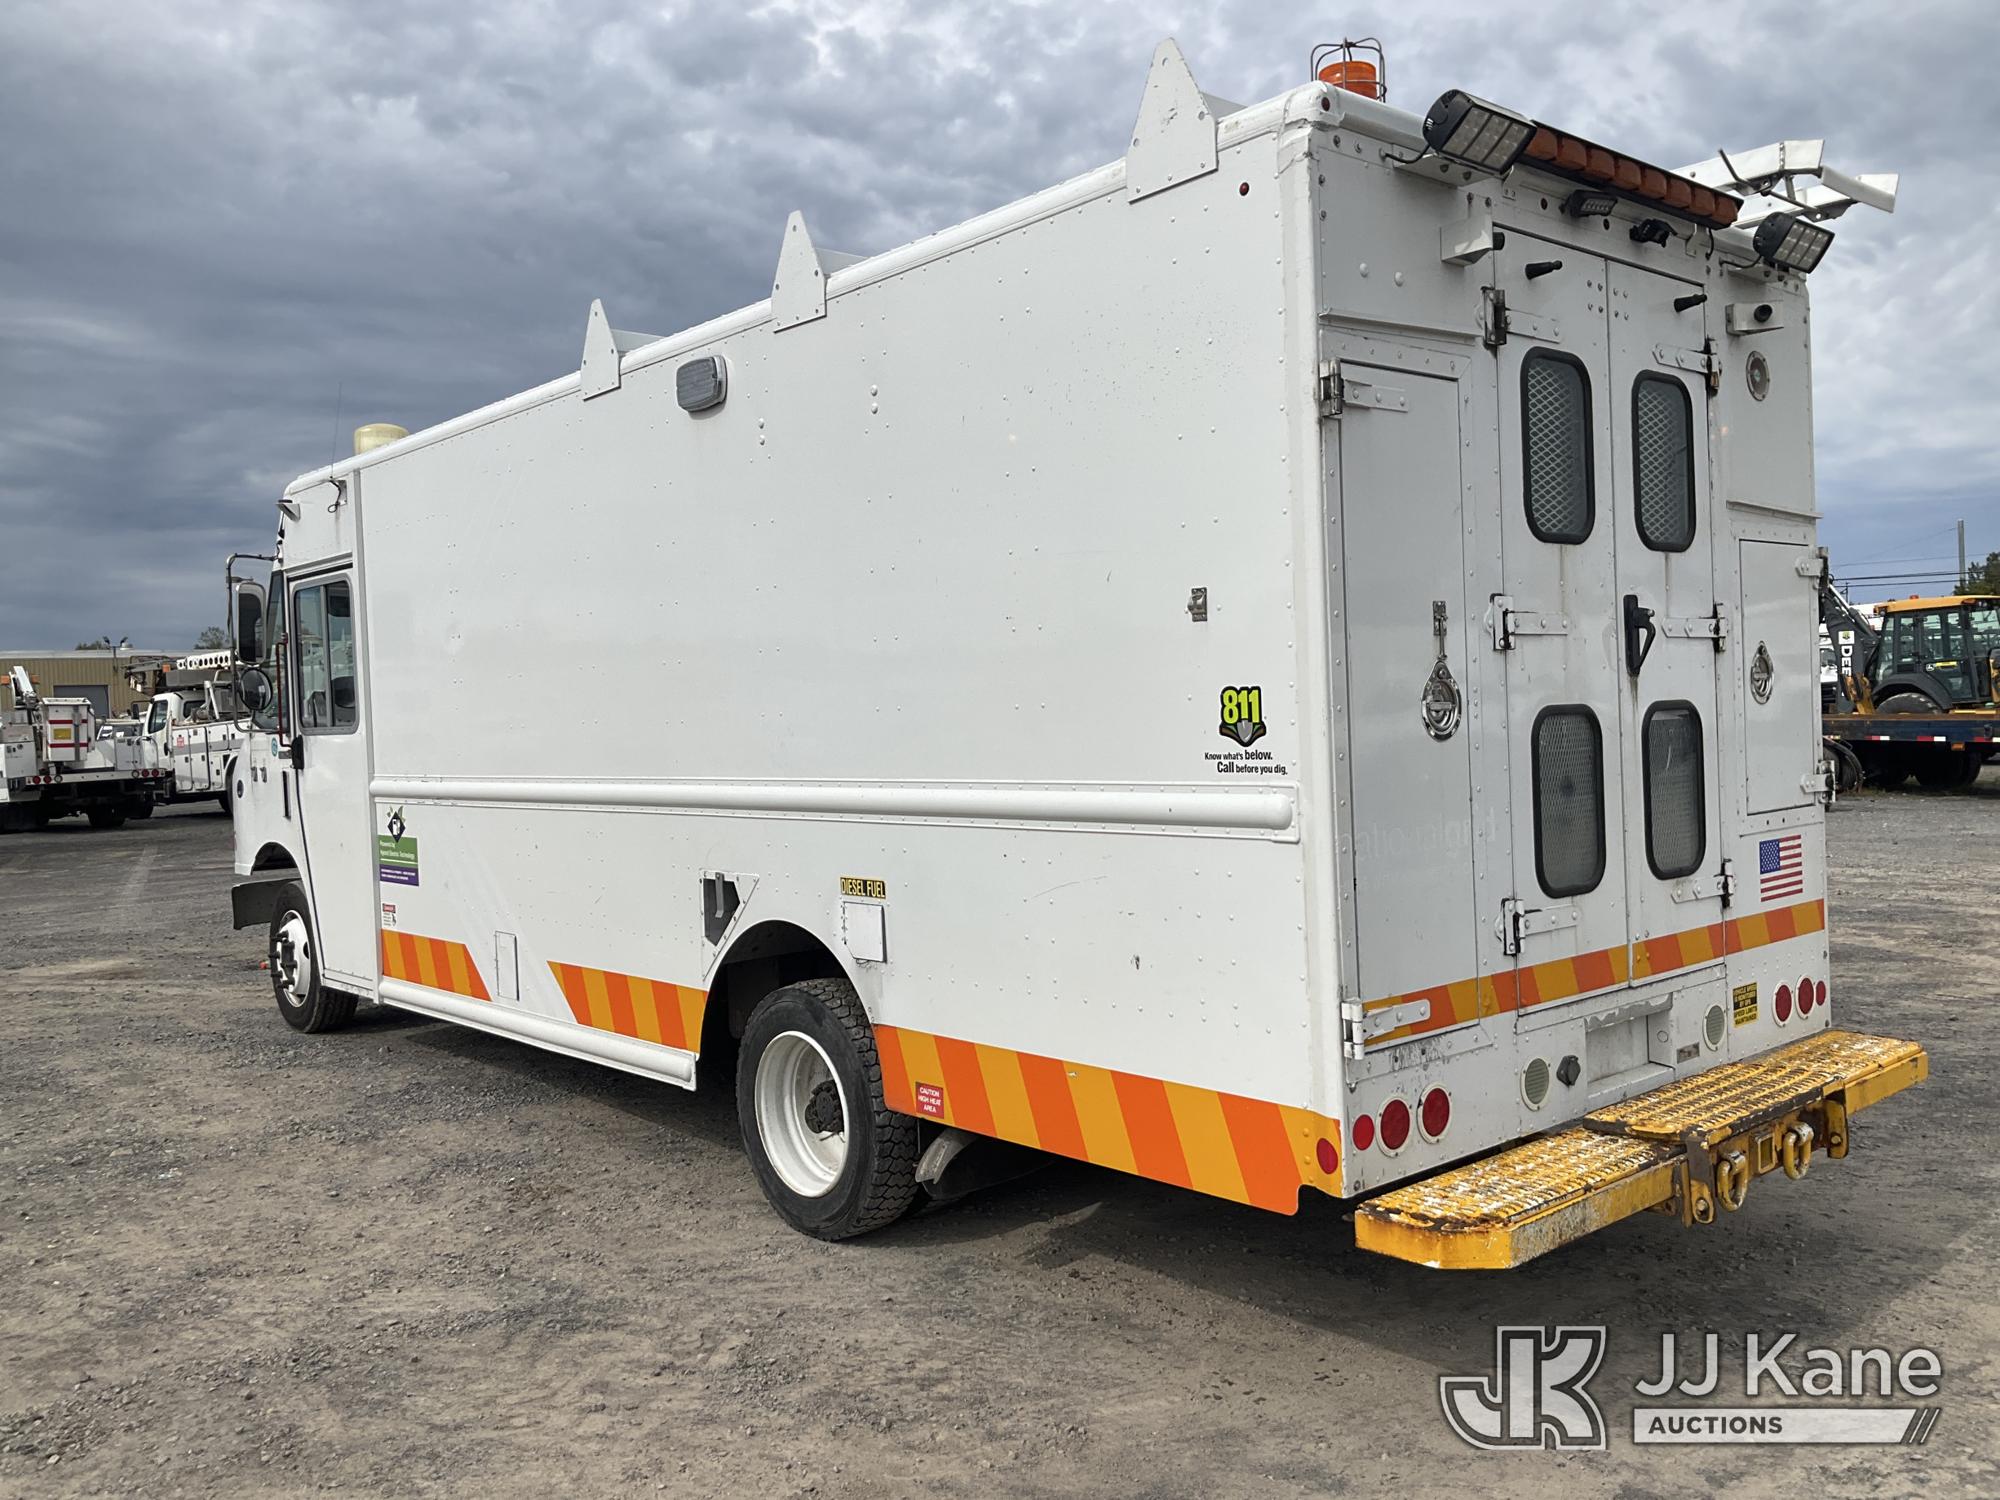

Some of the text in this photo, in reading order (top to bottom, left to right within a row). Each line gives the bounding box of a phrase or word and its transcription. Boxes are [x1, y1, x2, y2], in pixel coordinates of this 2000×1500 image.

[1222, 688, 1261, 724] 811
[1204, 749, 1273, 760] Know what's below.
[1217, 761, 1288, 775] Call before you dig.
[841, 878, 886, 898] DIESEL FUEL
[919, 1086, 940, 1098] CAUTION
[918, 1095, 942, 1106] HIGH HEAT
[923, 1104, 937, 1113] AREA
